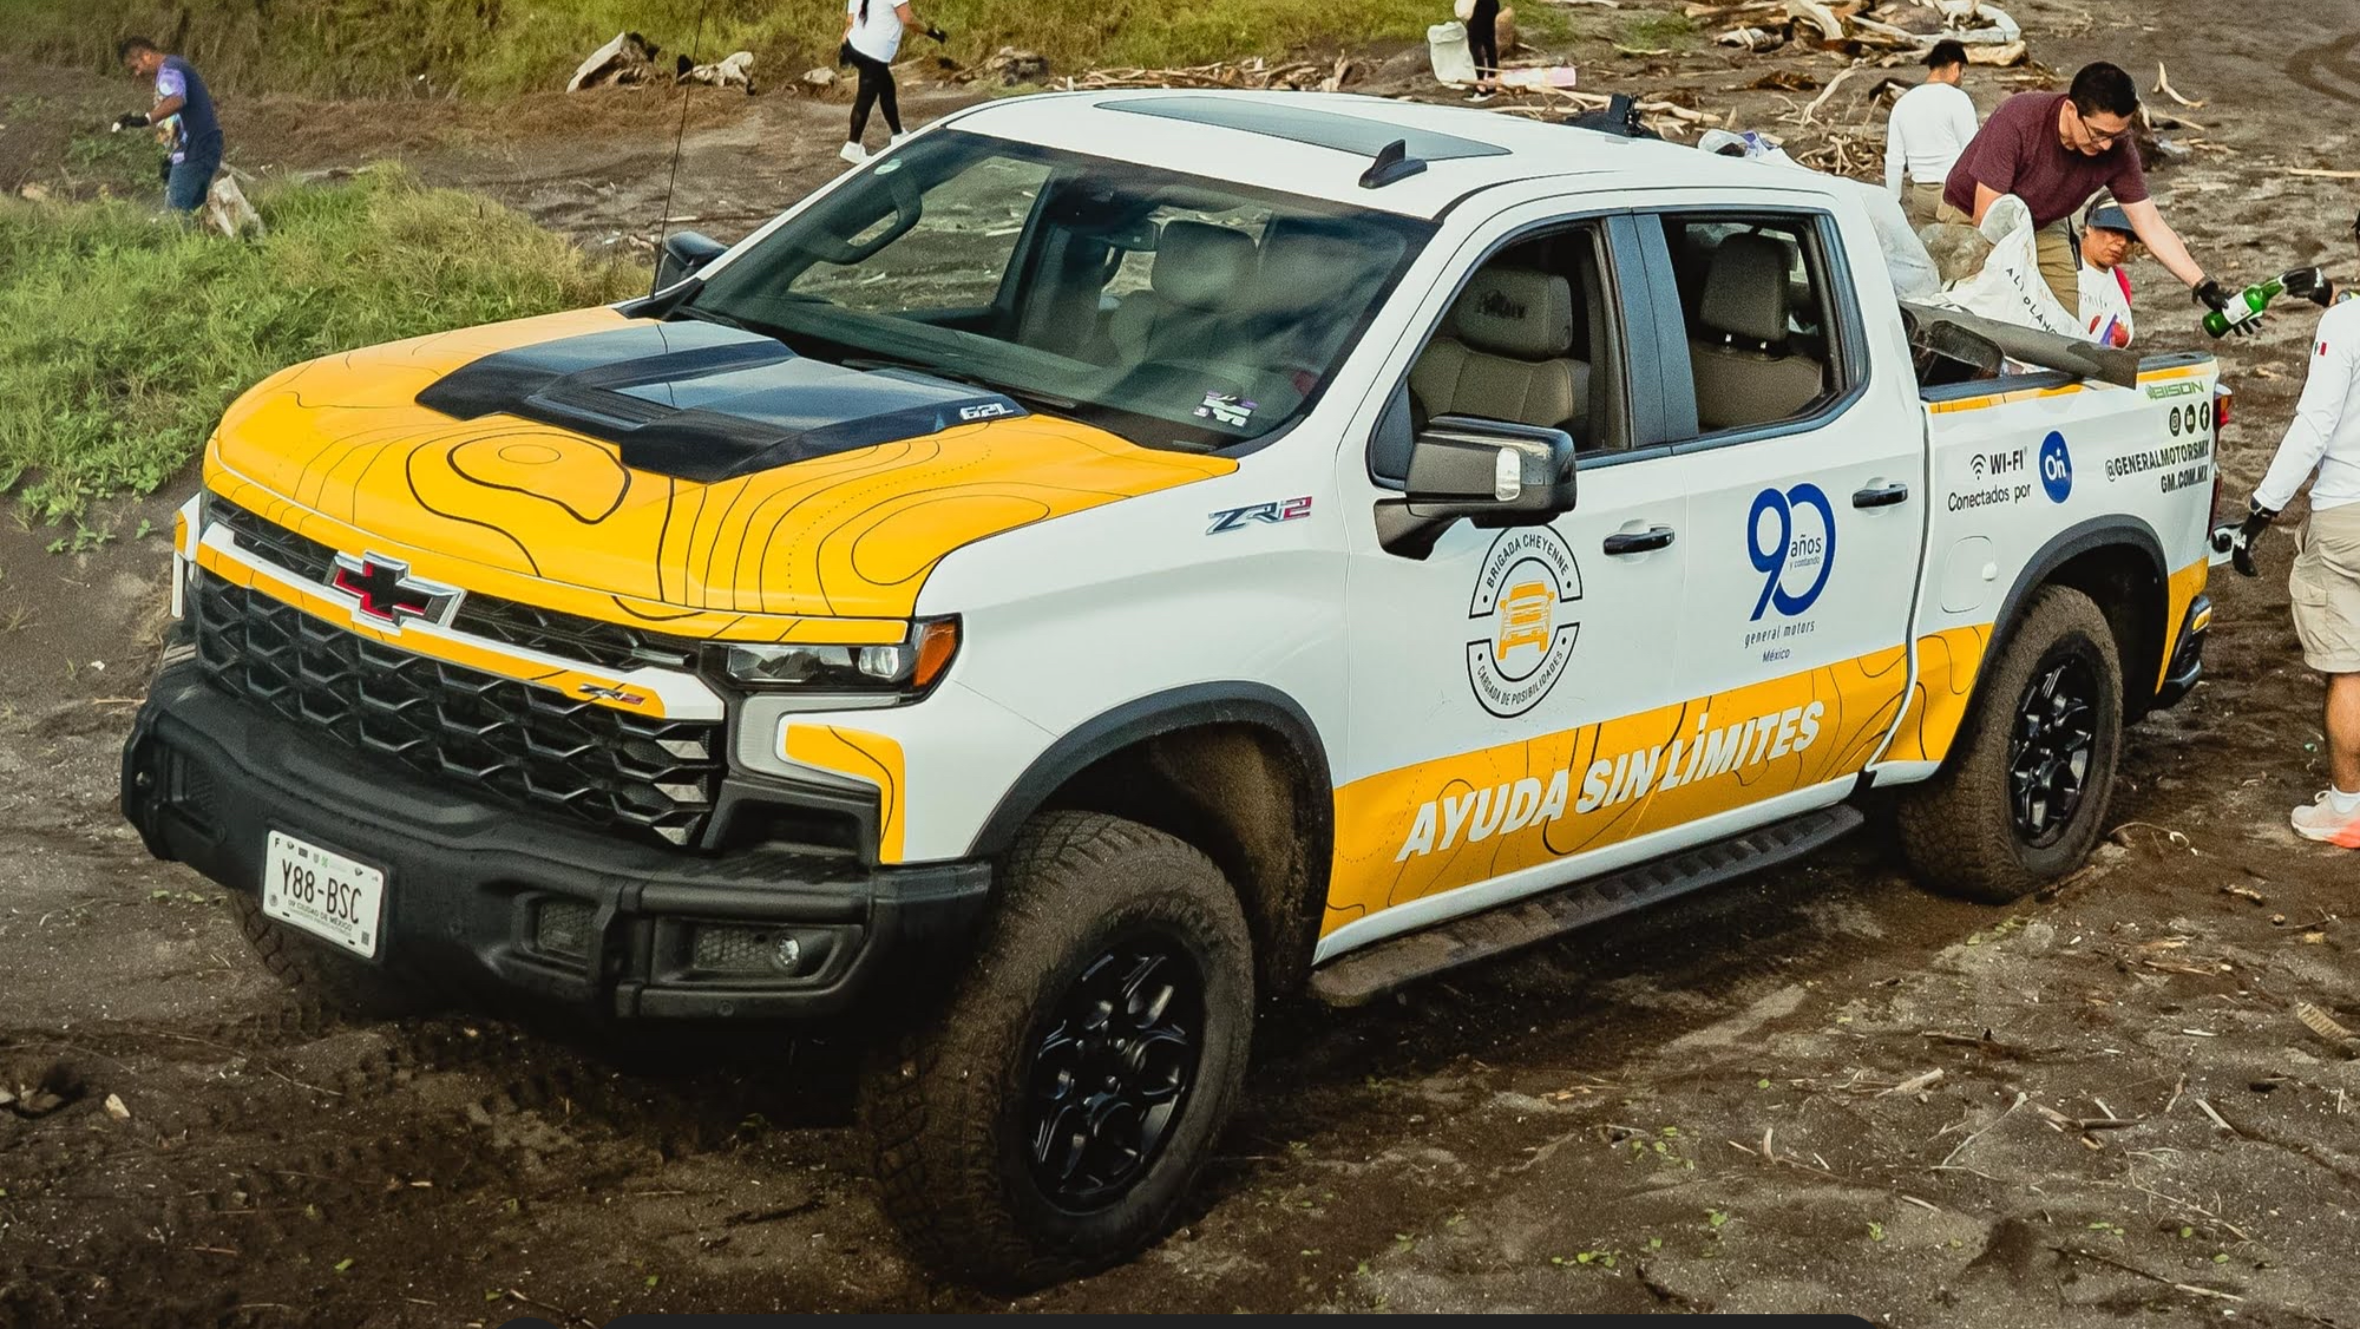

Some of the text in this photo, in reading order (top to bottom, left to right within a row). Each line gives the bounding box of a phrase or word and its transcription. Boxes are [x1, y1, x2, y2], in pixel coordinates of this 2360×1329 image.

[2152, 381, 2204, 400] BISON
[2045, 454, 2066, 481] On
[2104, 440, 2209, 482] @GENERALMOTORSMX
[2161, 464, 2208, 493] GM.COM.MX
[1948, 484, 2031, 512] Conectados por
[1206, 496, 1312, 536] ZR2
[1487, 534, 1569, 589] BRIGADA CHEYENNE
[1747, 483, 1836, 621] 90
[1790, 534, 1822, 557] años
[1744, 620, 1816, 648] general motors
[1762, 648, 1791, 663] México
[1477, 651, 1563, 706] CARGADA DE POSIBILIDADES
[1394, 769, 1570, 863] AYUDA
[1575, 746, 1661, 814] SIN
[282, 858, 361, 925] Y88-BSC
